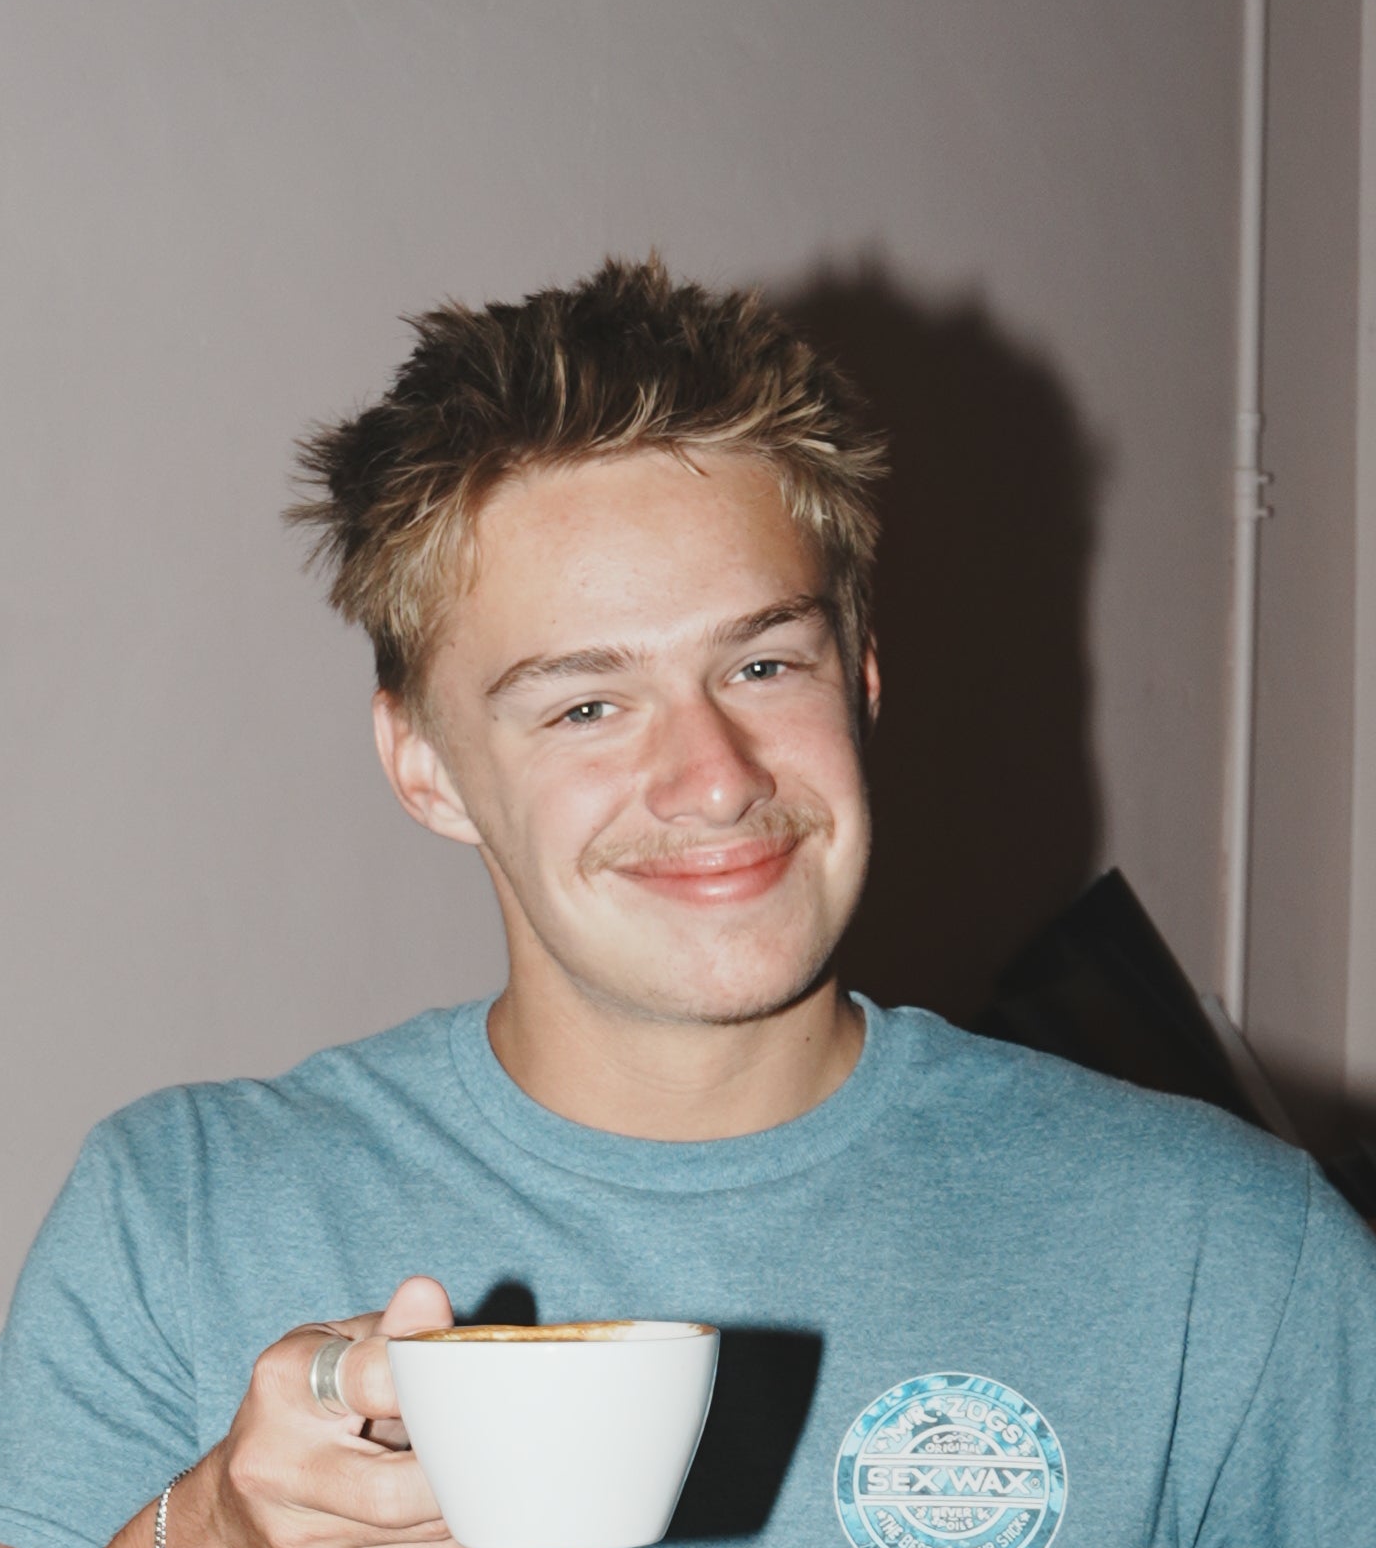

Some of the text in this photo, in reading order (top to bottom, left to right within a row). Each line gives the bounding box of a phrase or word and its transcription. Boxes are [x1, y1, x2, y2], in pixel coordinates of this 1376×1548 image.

[946, 1395, 1023, 1445] ZOGS
[867, 1467, 942, 1493] SEX
[880, 1515, 901, 1542] THE
[999, 1520, 1027, 1548] STICK
